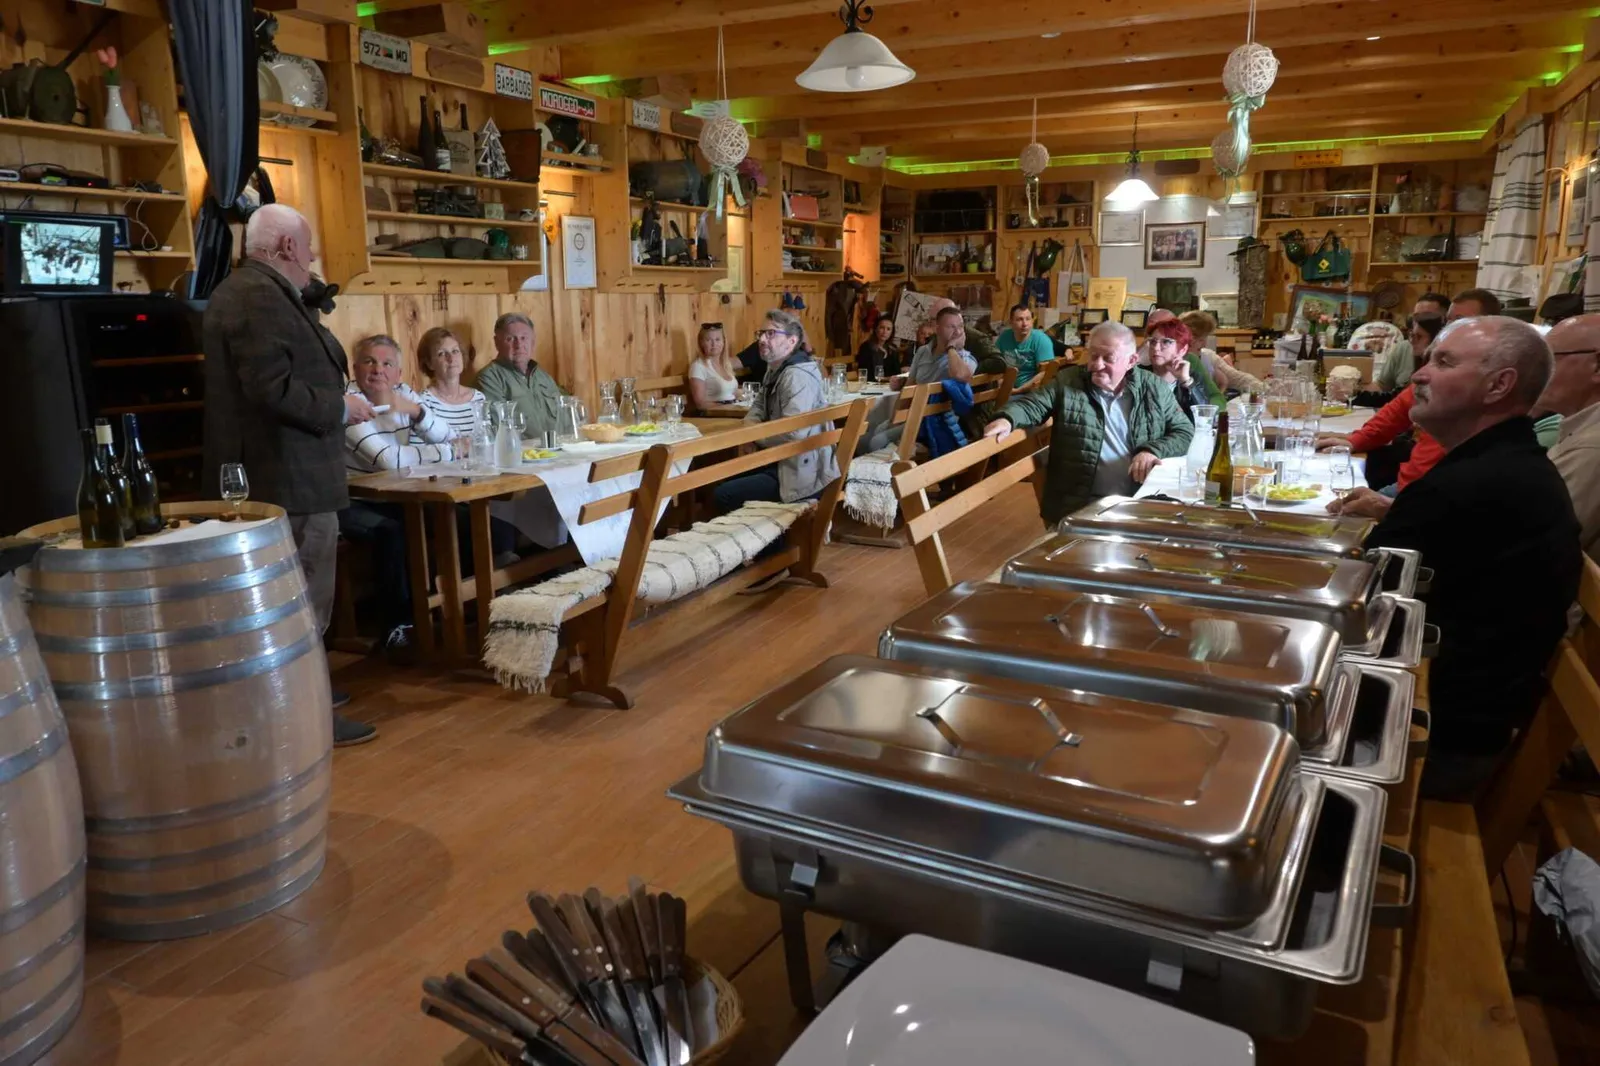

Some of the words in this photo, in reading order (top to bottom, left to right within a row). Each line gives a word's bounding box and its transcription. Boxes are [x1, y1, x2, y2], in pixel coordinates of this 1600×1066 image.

[363, 41, 381, 57] 972
[496, 73, 531, 97] BARBADOS
[541, 90, 579, 113] MOROCCO
